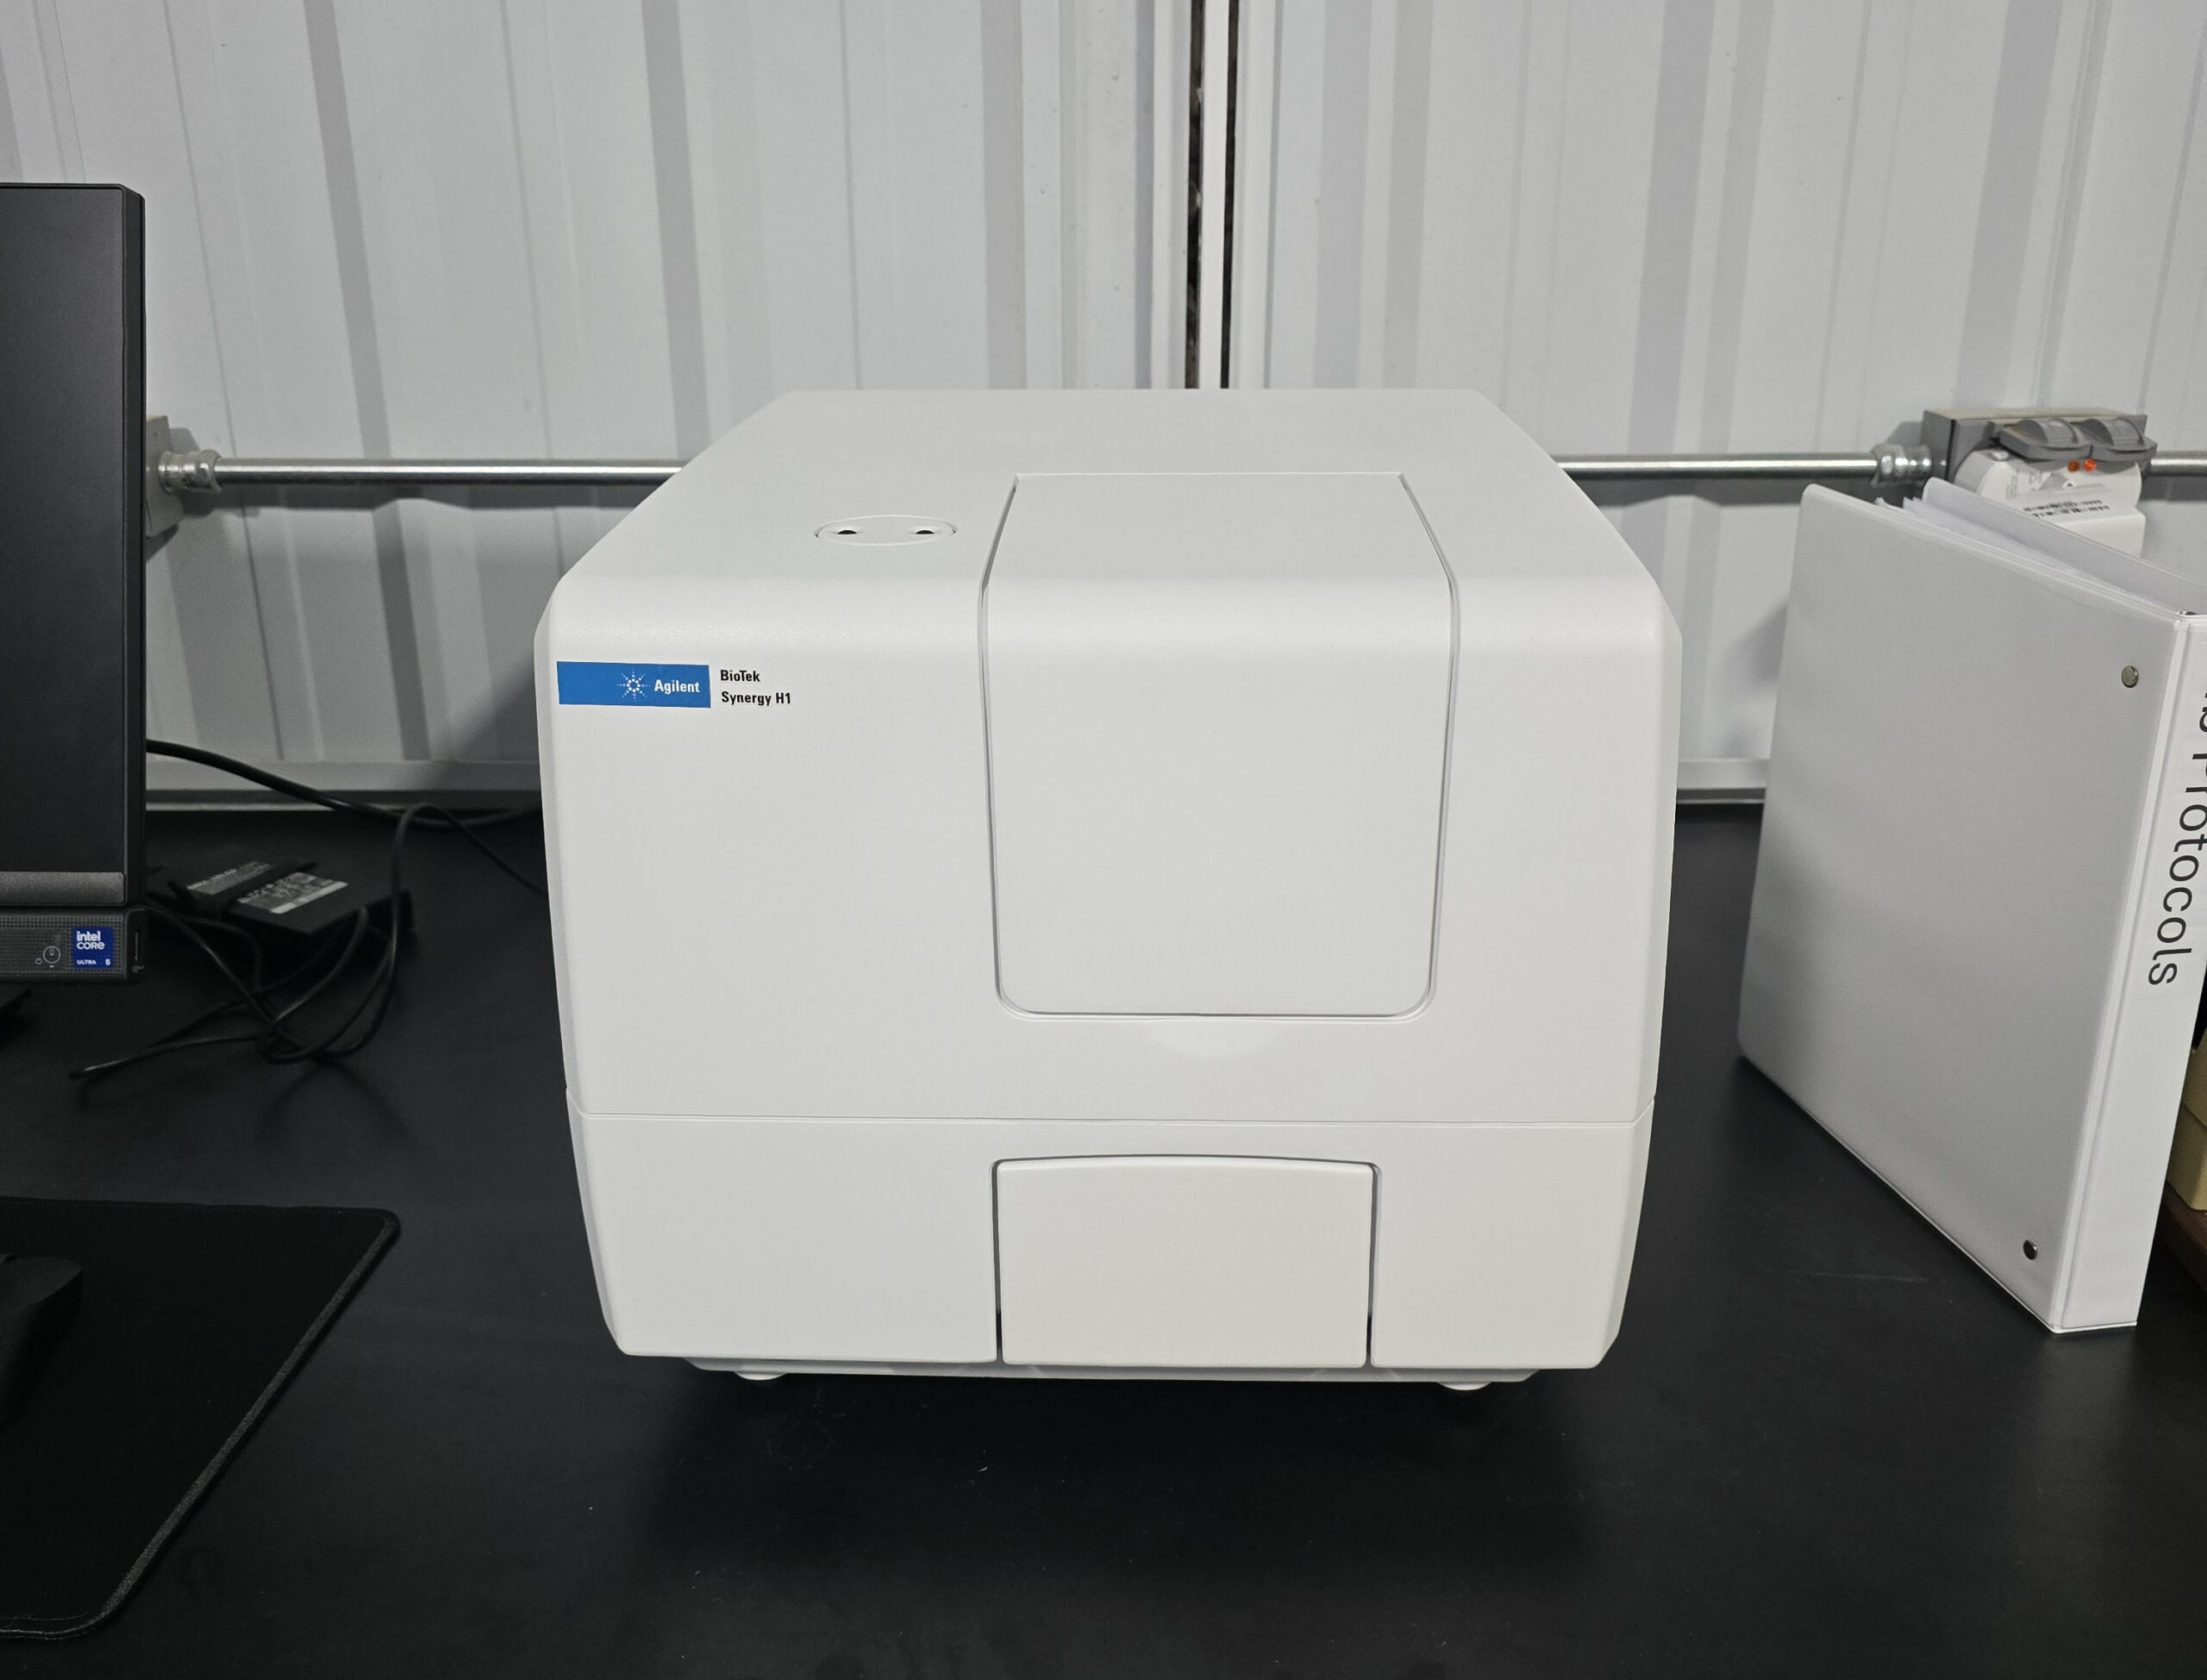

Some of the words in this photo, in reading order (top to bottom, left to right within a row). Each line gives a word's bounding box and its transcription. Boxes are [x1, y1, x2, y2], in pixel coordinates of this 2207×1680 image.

[720, 670, 760, 683] BioTek
[653, 679, 700, 694] Agilent
[721, 691, 772, 706] Synergy
[775, 693, 791, 704] H1
[76, 931, 101, 941] intel
